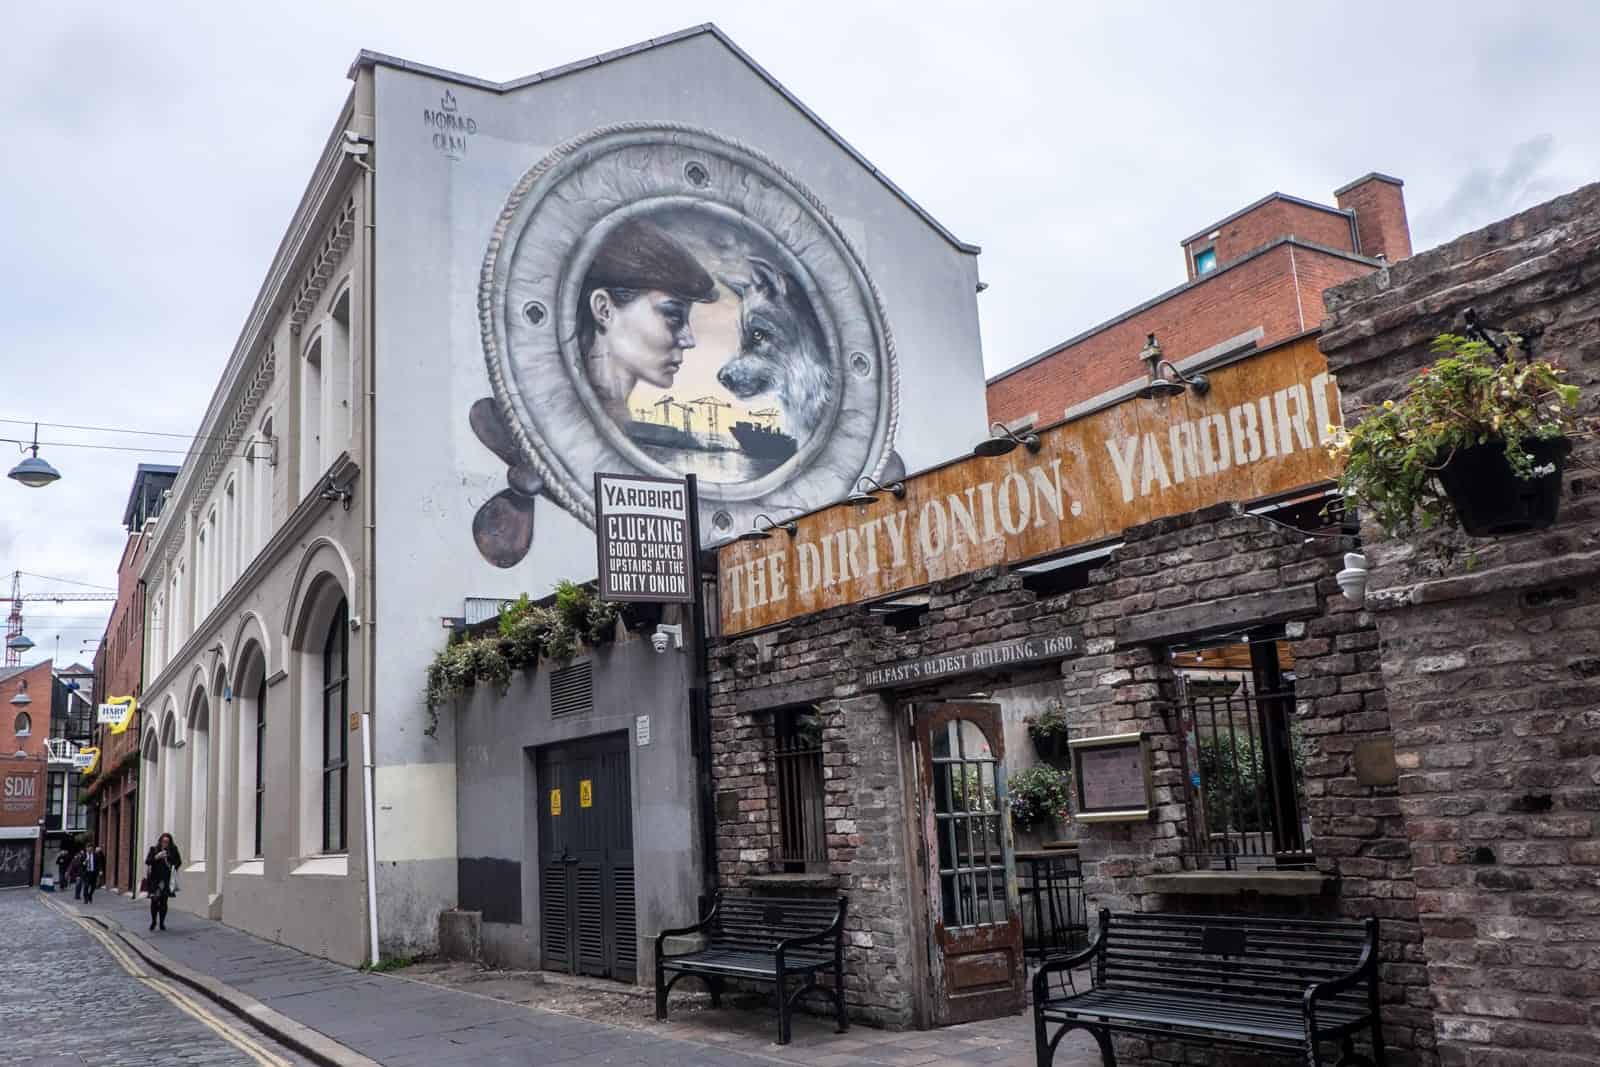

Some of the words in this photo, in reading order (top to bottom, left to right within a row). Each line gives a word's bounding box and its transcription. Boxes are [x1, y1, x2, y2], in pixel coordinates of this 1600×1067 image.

[604, 483, 684, 511] YARDBIRD
[608, 517, 682, 542] CLUCKING
[726, 550, 789, 614] THE
[796, 509, 908, 595] DIRTY
[918, 458, 1082, 560] ONION.
[609, 542, 637, 558] GOOD
[641, 543, 684, 560] CHICKEN
[610, 558, 653, 573] UPSTAIRS
[655, 560, 666, 573] AT
[668, 561, 685, 574] THE
[611, 573, 646, 592] DIRTY
[649, 575, 686, 593] ONION
[865, 663, 920, 687] BELFAST'S
[924, 654, 968, 675] OLDEST
[972, 642, 1038, 668] BUILDING.
[1043, 635, 1078, 655] 1680.
[102, 706, 126, 716] HARP
[4, 776, 35, 797] SDM
